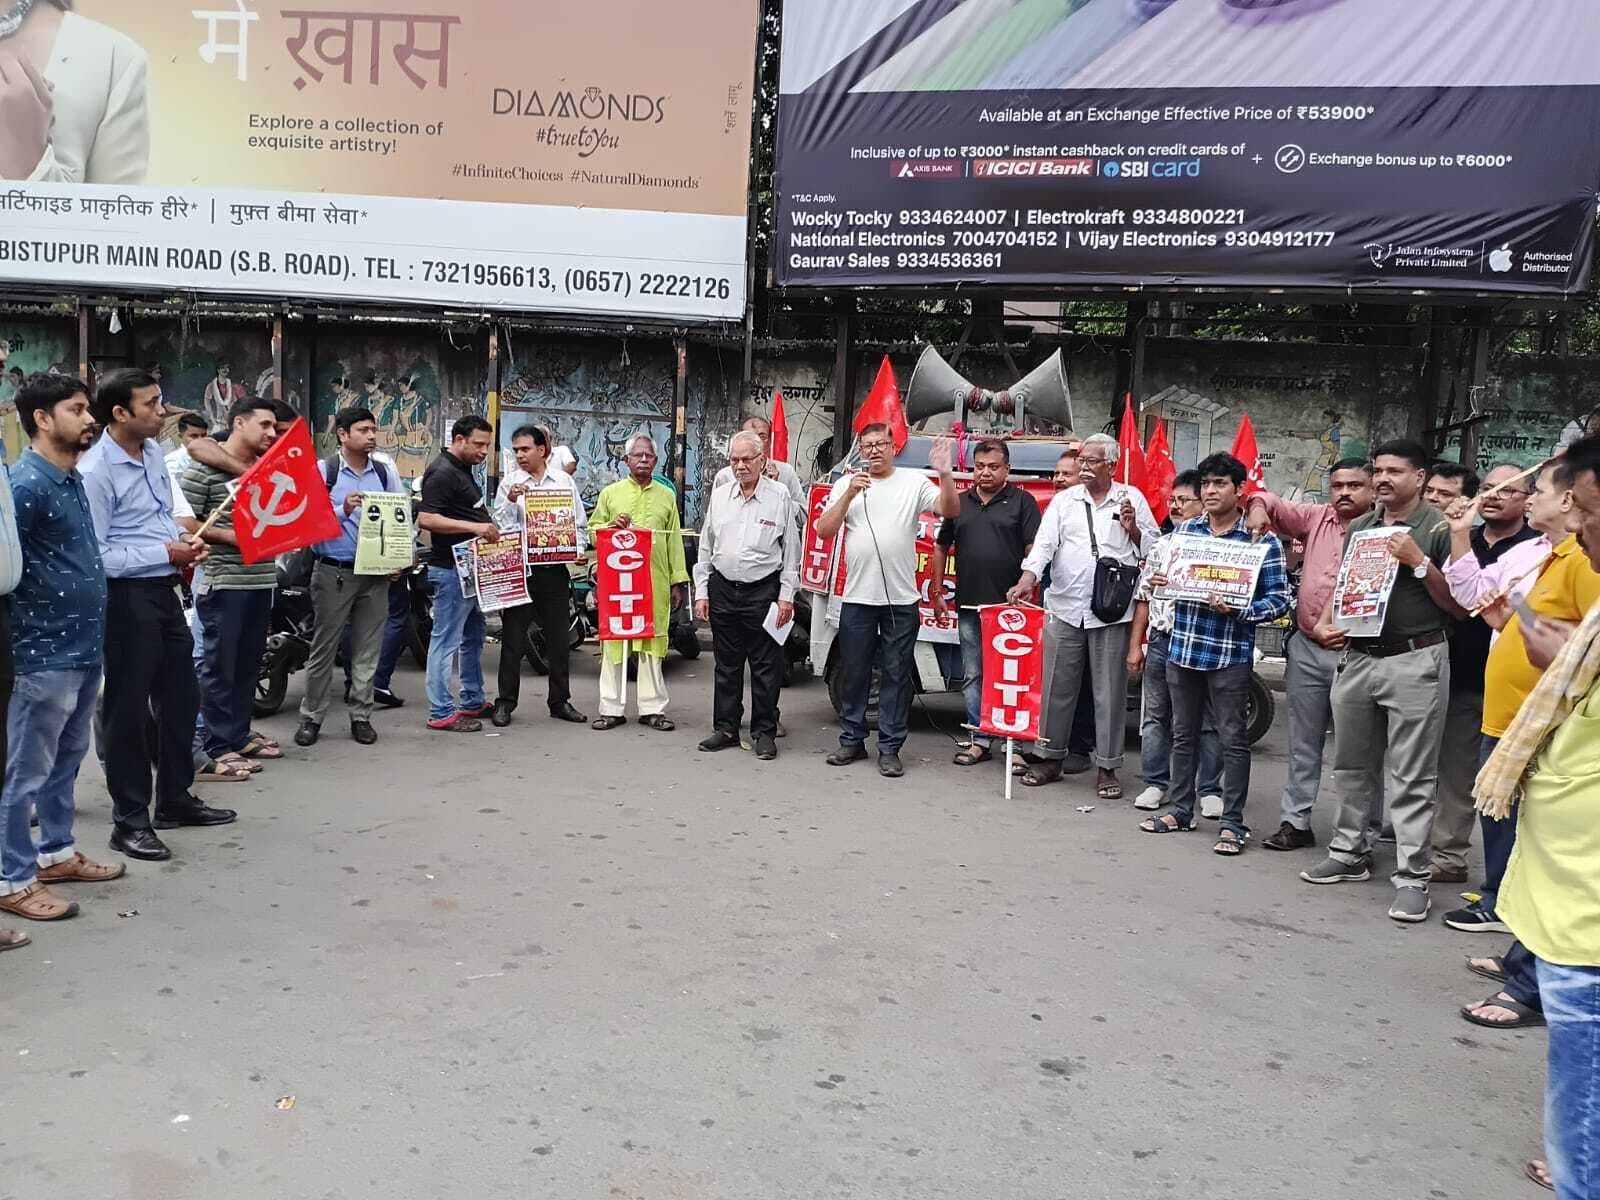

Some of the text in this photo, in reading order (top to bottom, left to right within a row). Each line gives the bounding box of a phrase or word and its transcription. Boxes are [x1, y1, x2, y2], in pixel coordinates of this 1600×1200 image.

[493, 87, 666, 123] DIAMONDS
[979, 109, 1042, 122] Available
[1046, 110, 1061, 122] at
[1066, 111, 1083, 122] an
[1088, 108, 1160, 124] Exchange
[1164, 107, 1229, 120] Effective
[1235, 107, 1275, 120] Price
[1278, 107, 1292, 120] of
[249, 114, 443, 136] Explore a collection of
[248, 135, 396, 155] exquisite artistry!
[851, 146, 905, 158] Inclusive
[909, 146, 922, 158] of
[925, 149, 941, 161] up
[944, 147, 957, 158] to
[1013, 145, 1057, 157] instant
[1061, 145, 1124, 157] cashback
[1127, 147, 1144, 157] on
[1148, 144, 1186, 156] credit
[1191, 143, 1227, 156] cards
[1231, 143, 1245, 155] of
[987, 161, 1091, 175] ICICI Bank
[1121, 159, 1200, 177] SBI card
[1309, 153, 1373, 168] Exchange
[1376, 153, 1416, 166] bonus
[1419, 156, 1436, 170] up
[1439, 154, 1453, 166] to
[452, 163, 699, 190] #InfiniteChoices #NaturalDiamonds
[813, 194, 837, 205] Apply.
[80, 195, 152, 223] प्राकृतिक
[278, 201, 315, 223] बीमा
[1027, 209, 1245, 225] Electrokraft 9334800221
[791, 210, 1006, 228] Wocky Tocky 9334624007
[790, 232, 1057, 247] National Electronics 7004704152
[1079, 231, 1335, 249] Vijay Electronics 9304912177
[790, 253, 1002, 268] Gaurav Sales 9334536361
[1424, 247, 1474, 258] Infosystem
[1523, 252, 1573, 261] Authorised
[0, 240, 99, 265] BISTUPUR
[107, 245, 158, 267] MAIN
[166, 248, 222, 270] ROAD
[230, 250, 277, 275] (S.B.
[285, 254, 356, 281] ROAD).
[365, 258, 400, 280] TEL
[422, 261, 557, 292] 7321956613,
[565, 269, 631, 297] (0657)
[640, 273, 730, 300] 2222126
[1395, 258, 1467, 267] Private Limited
[1522, 263, 1570, 272] Distributor
[606, 550, 645, 636] CITU
[991, 632, 1034, 732] CITU
